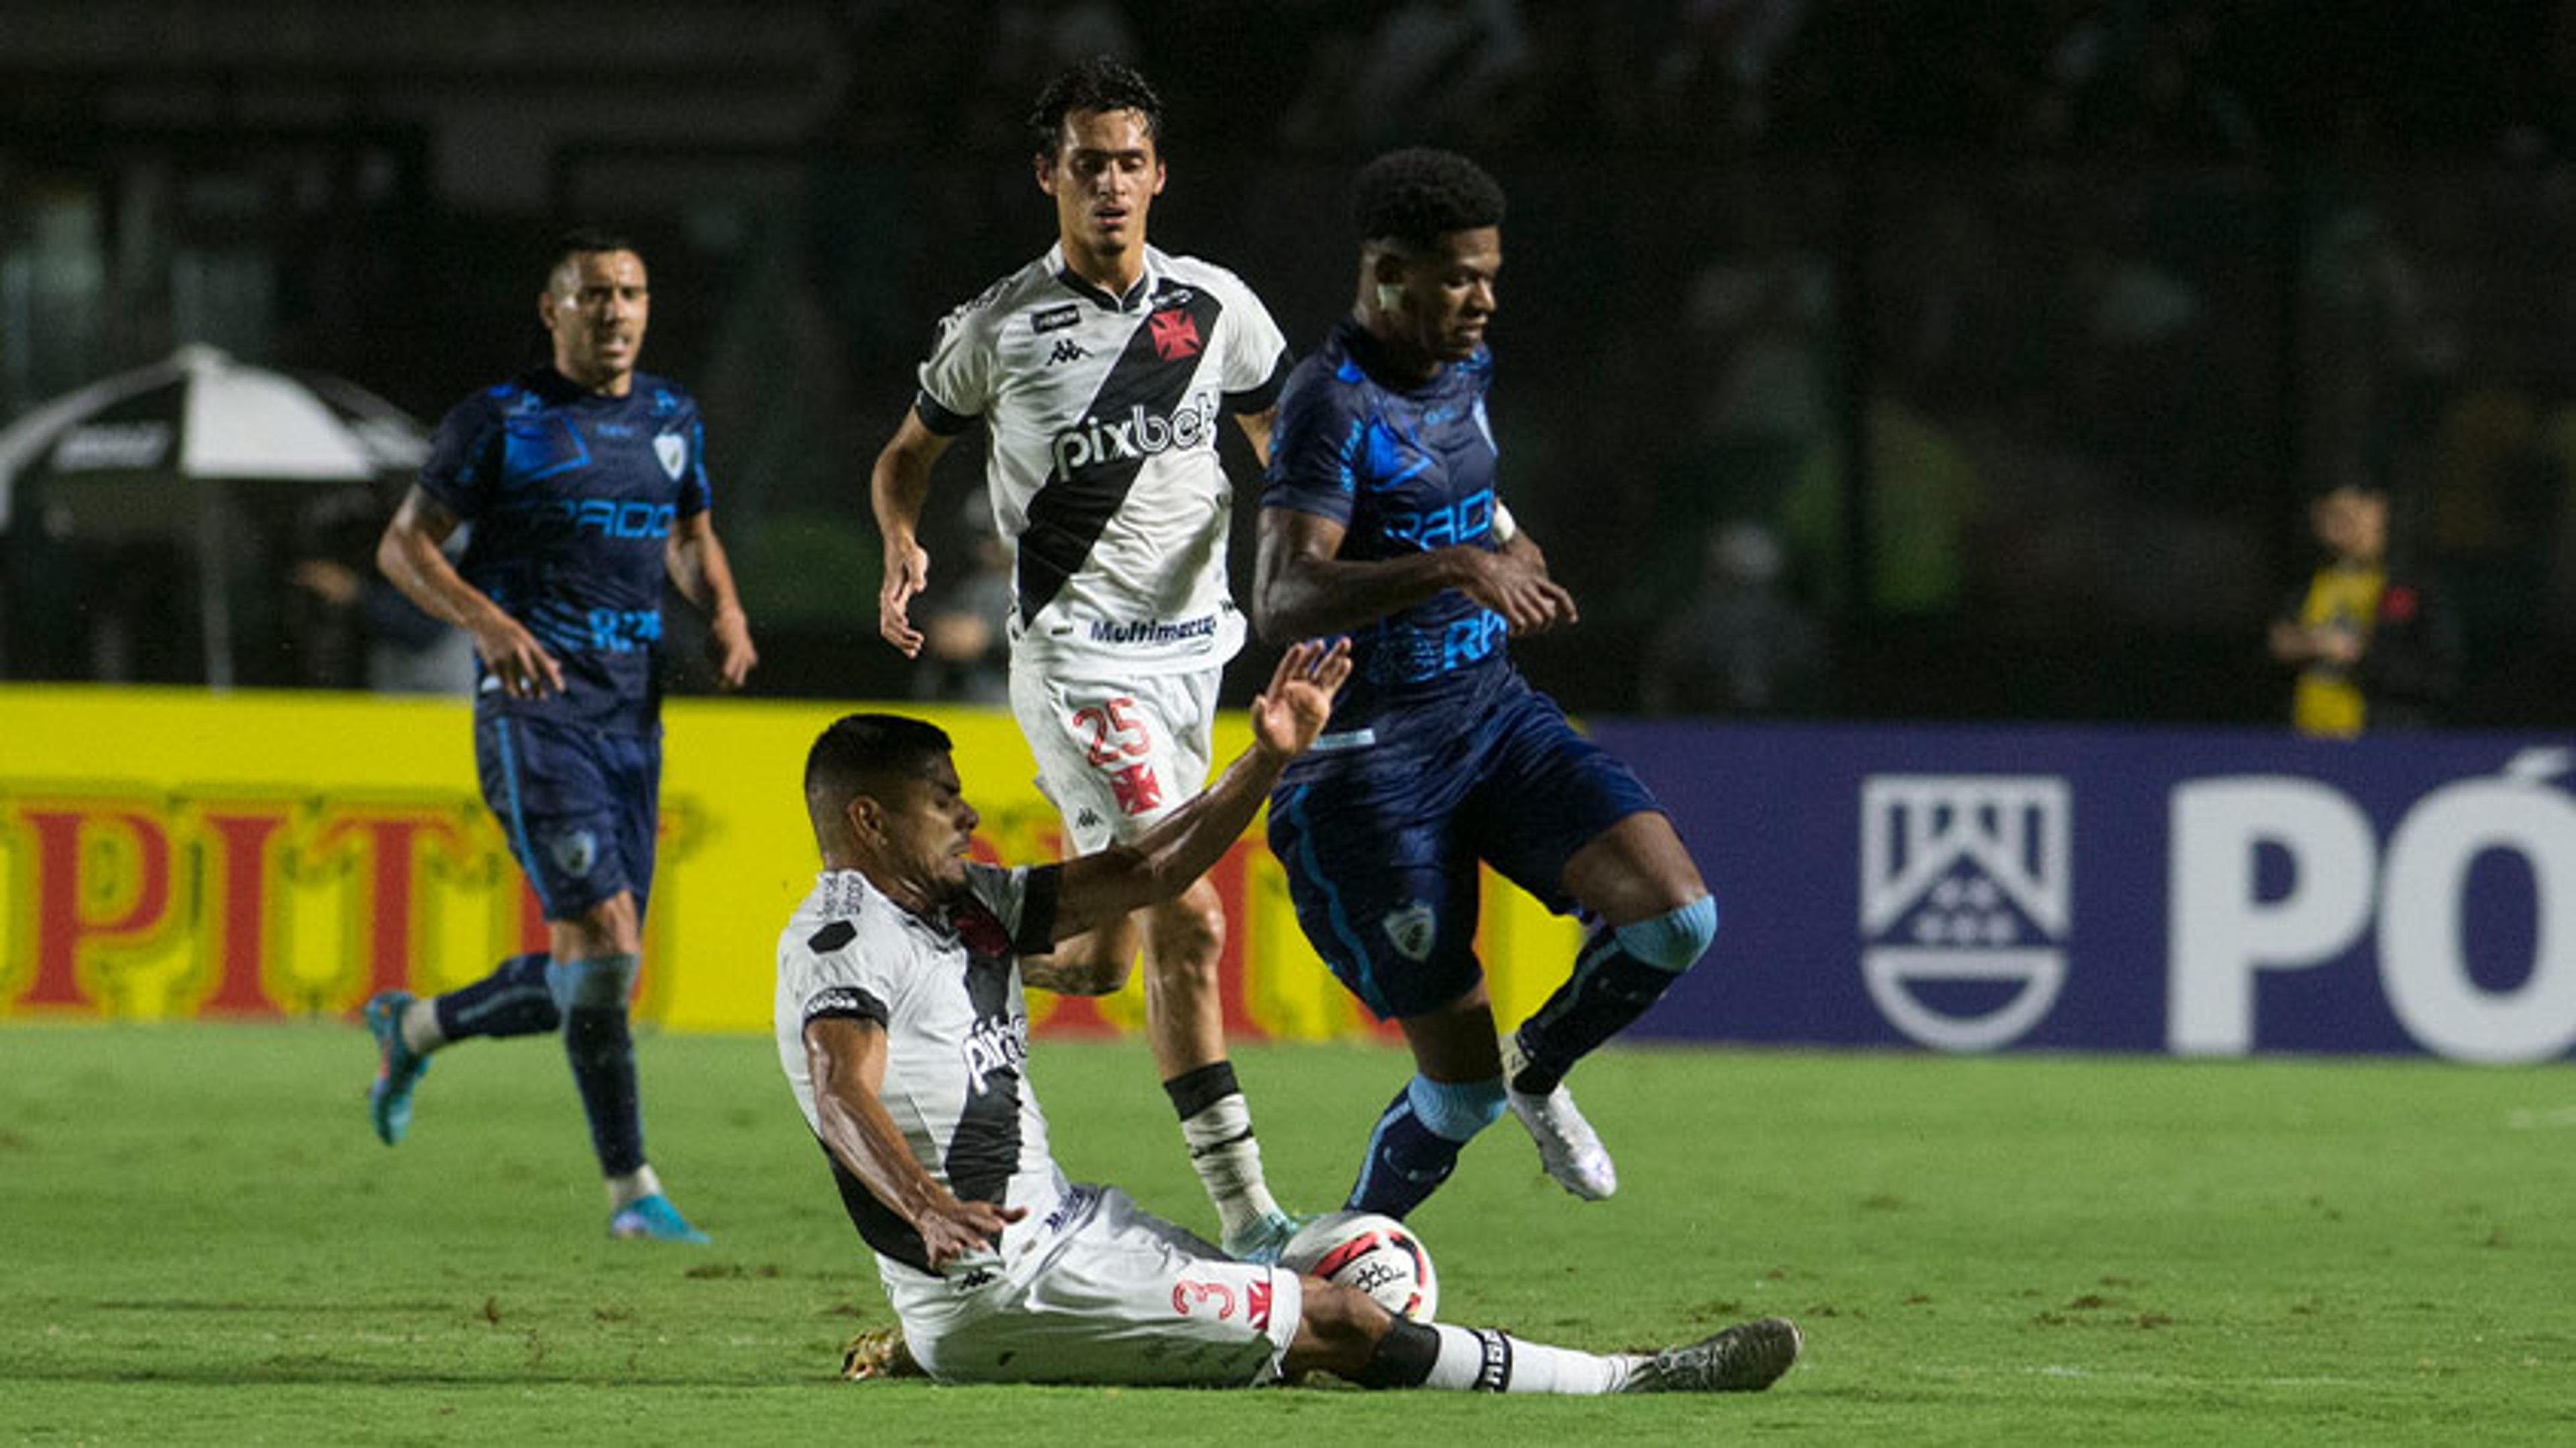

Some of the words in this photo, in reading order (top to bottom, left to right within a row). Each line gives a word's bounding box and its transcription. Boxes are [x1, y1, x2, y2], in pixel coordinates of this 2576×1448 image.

[1073, 697, 1150, 768] 25
[2165, 746, 2576, 1067] PÓ
[1172, 1280, 1236, 1320] 3
